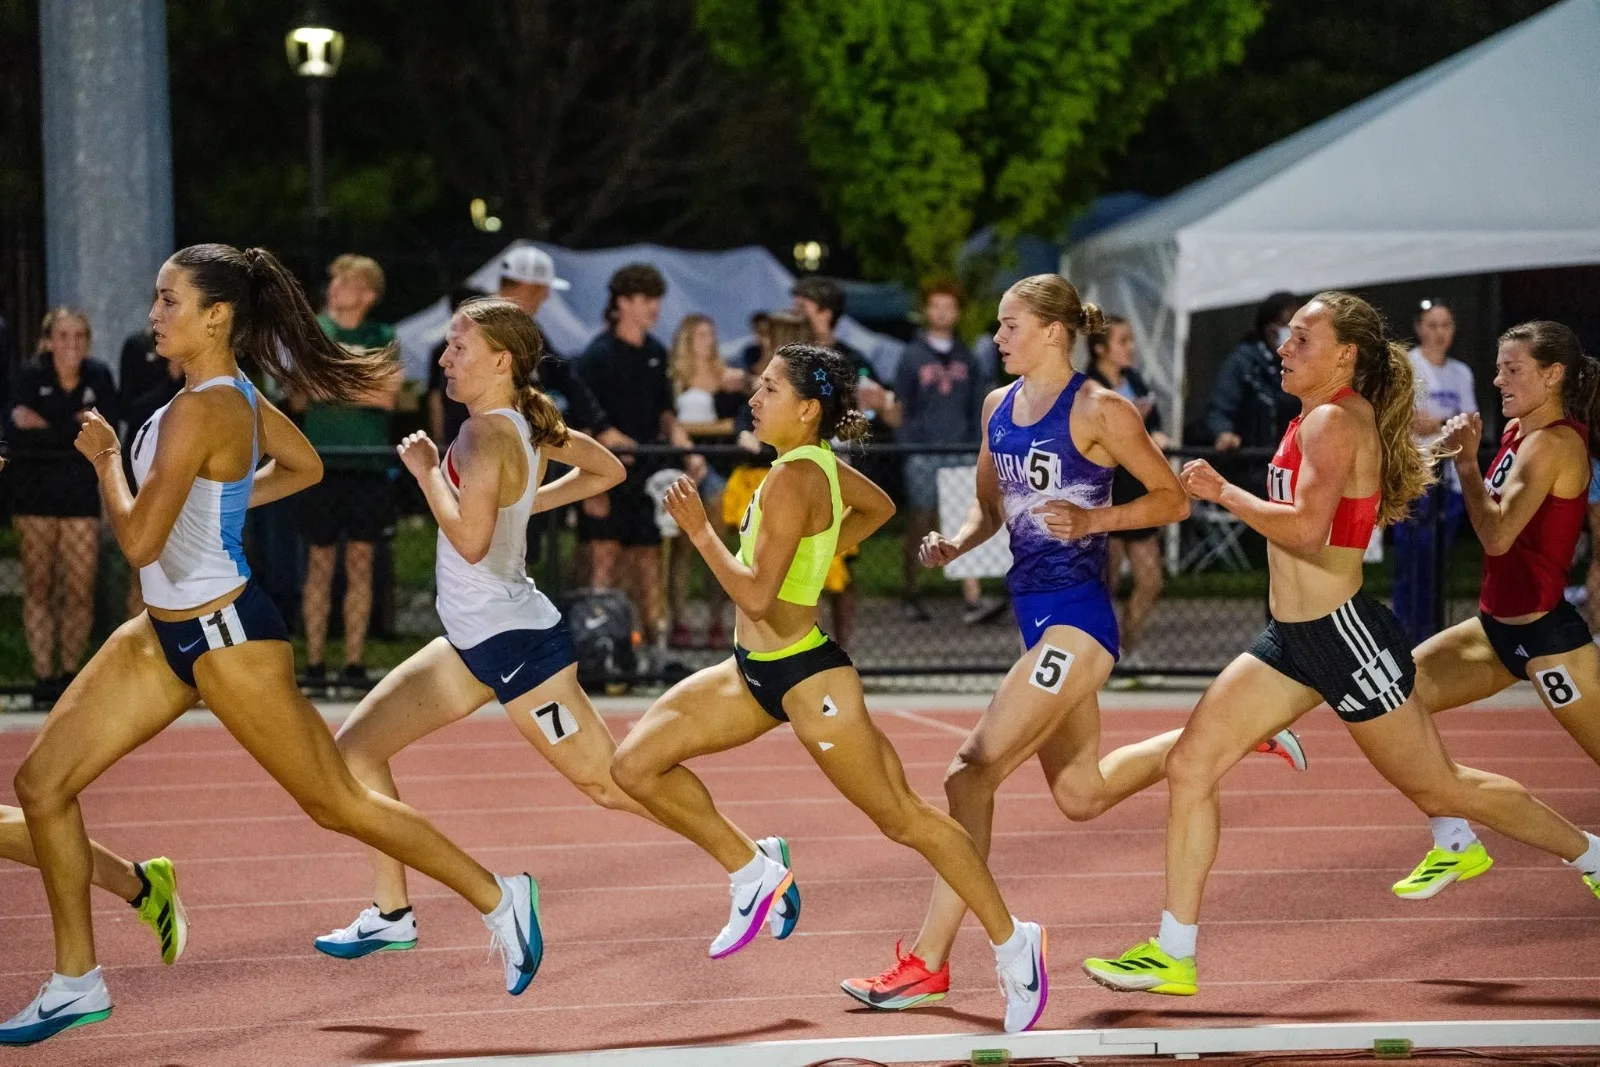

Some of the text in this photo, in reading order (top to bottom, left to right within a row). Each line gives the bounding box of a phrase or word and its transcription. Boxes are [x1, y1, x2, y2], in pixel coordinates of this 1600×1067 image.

[134, 421, 152, 461] 1
[991, 451, 1062, 489] URMN
[1030, 452, 1051, 491] 5
[1270, 466, 1285, 501] 11
[1492, 453, 1513, 489] 8
[206, 609, 235, 648] 1
[1035, 648, 1068, 688] 5
[1357, 655, 1395, 695] 11
[1542, 671, 1574, 705] 8
[535, 701, 566, 739] 7
